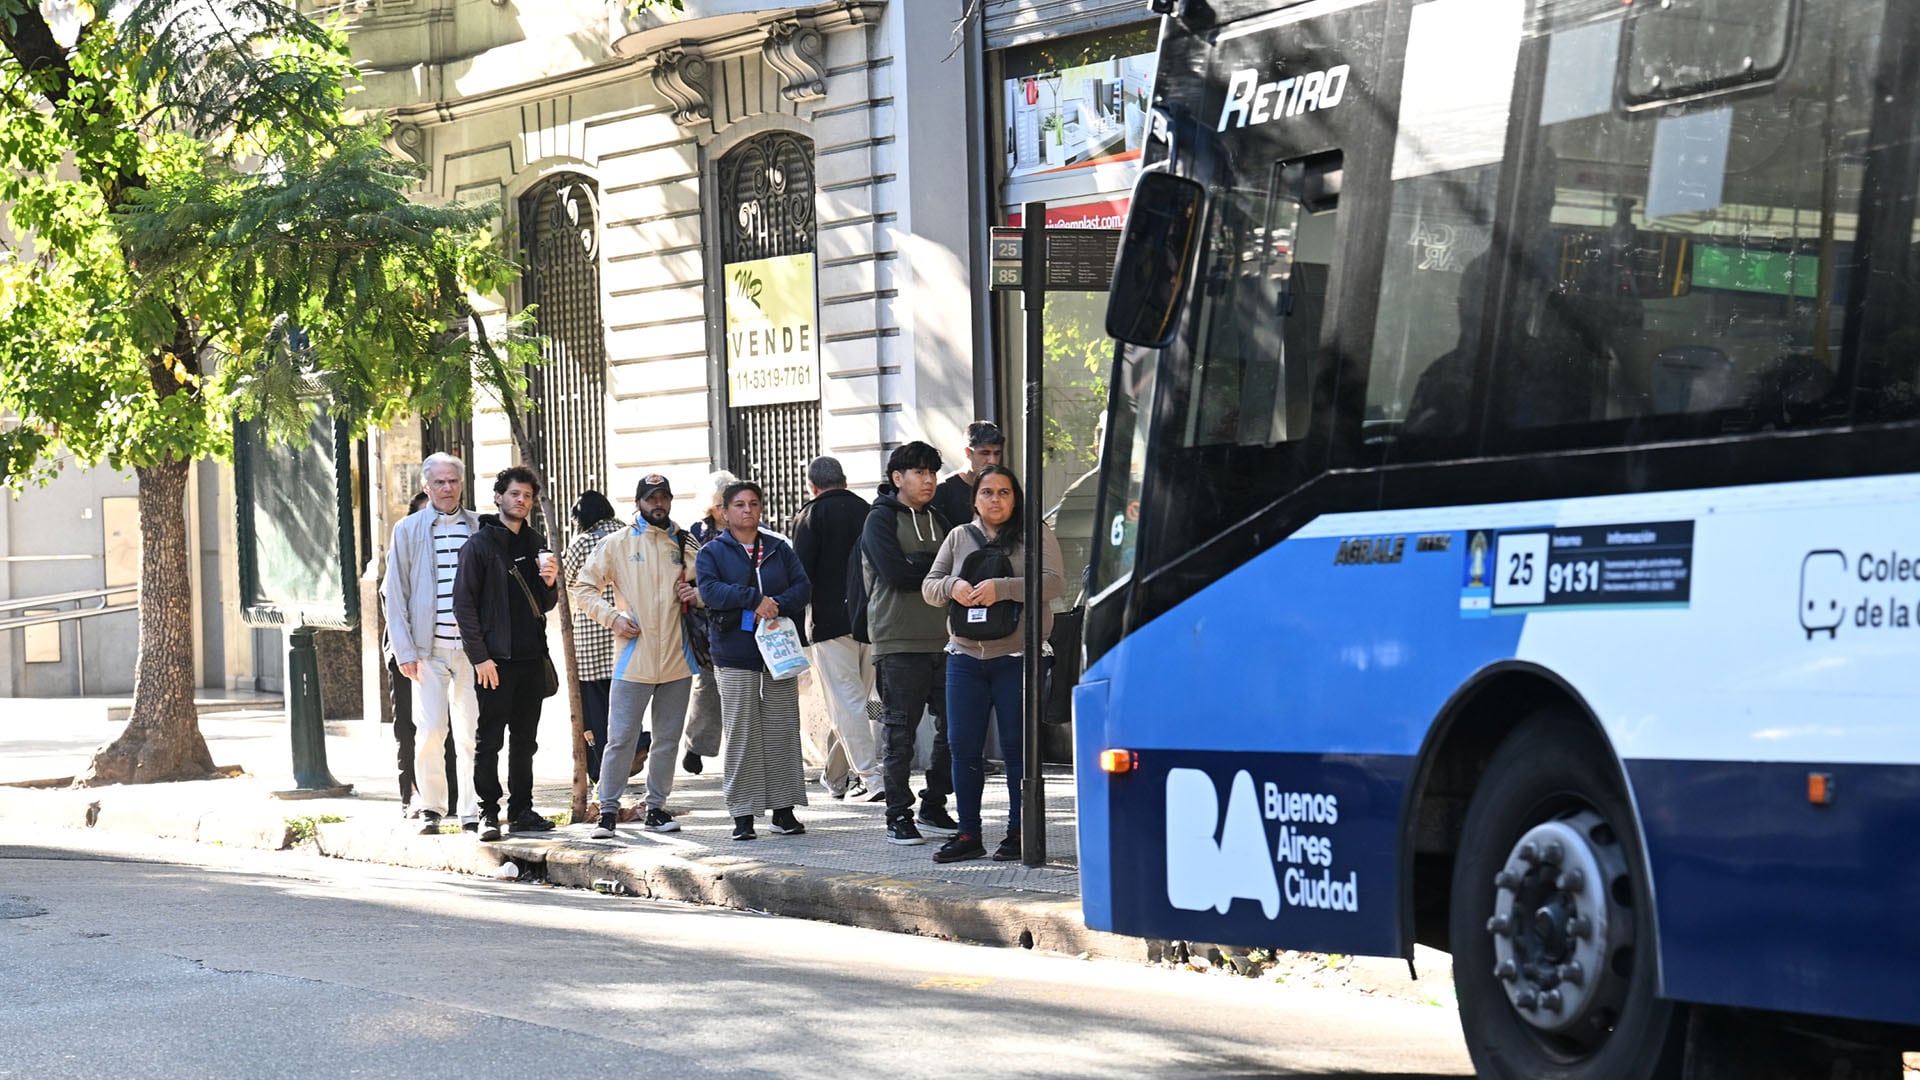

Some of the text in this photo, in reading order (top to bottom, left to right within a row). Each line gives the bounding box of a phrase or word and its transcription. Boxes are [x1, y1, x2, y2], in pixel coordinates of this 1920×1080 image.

[1217, 64, 1350, 132] RETIRO
[998, 242, 1018, 257] 25
[998, 269, 1018, 283] 85
[732, 324, 810, 358] VENDE
[736, 364, 811, 390] 11-5319-7761
[1334, 535, 1407, 566] AGRALE
[1508, 552, 1534, 586] 25
[1549, 560, 1599, 593] 9131
[1855, 597, 1883, 628] de
[1890, 597, 1909, 628] la
[1264, 781, 1338, 825] Buenos
[1166, 767, 1280, 920] BA
[1277, 825, 1333, 867] Aires
[1284, 867, 1359, 912] Ciudad
